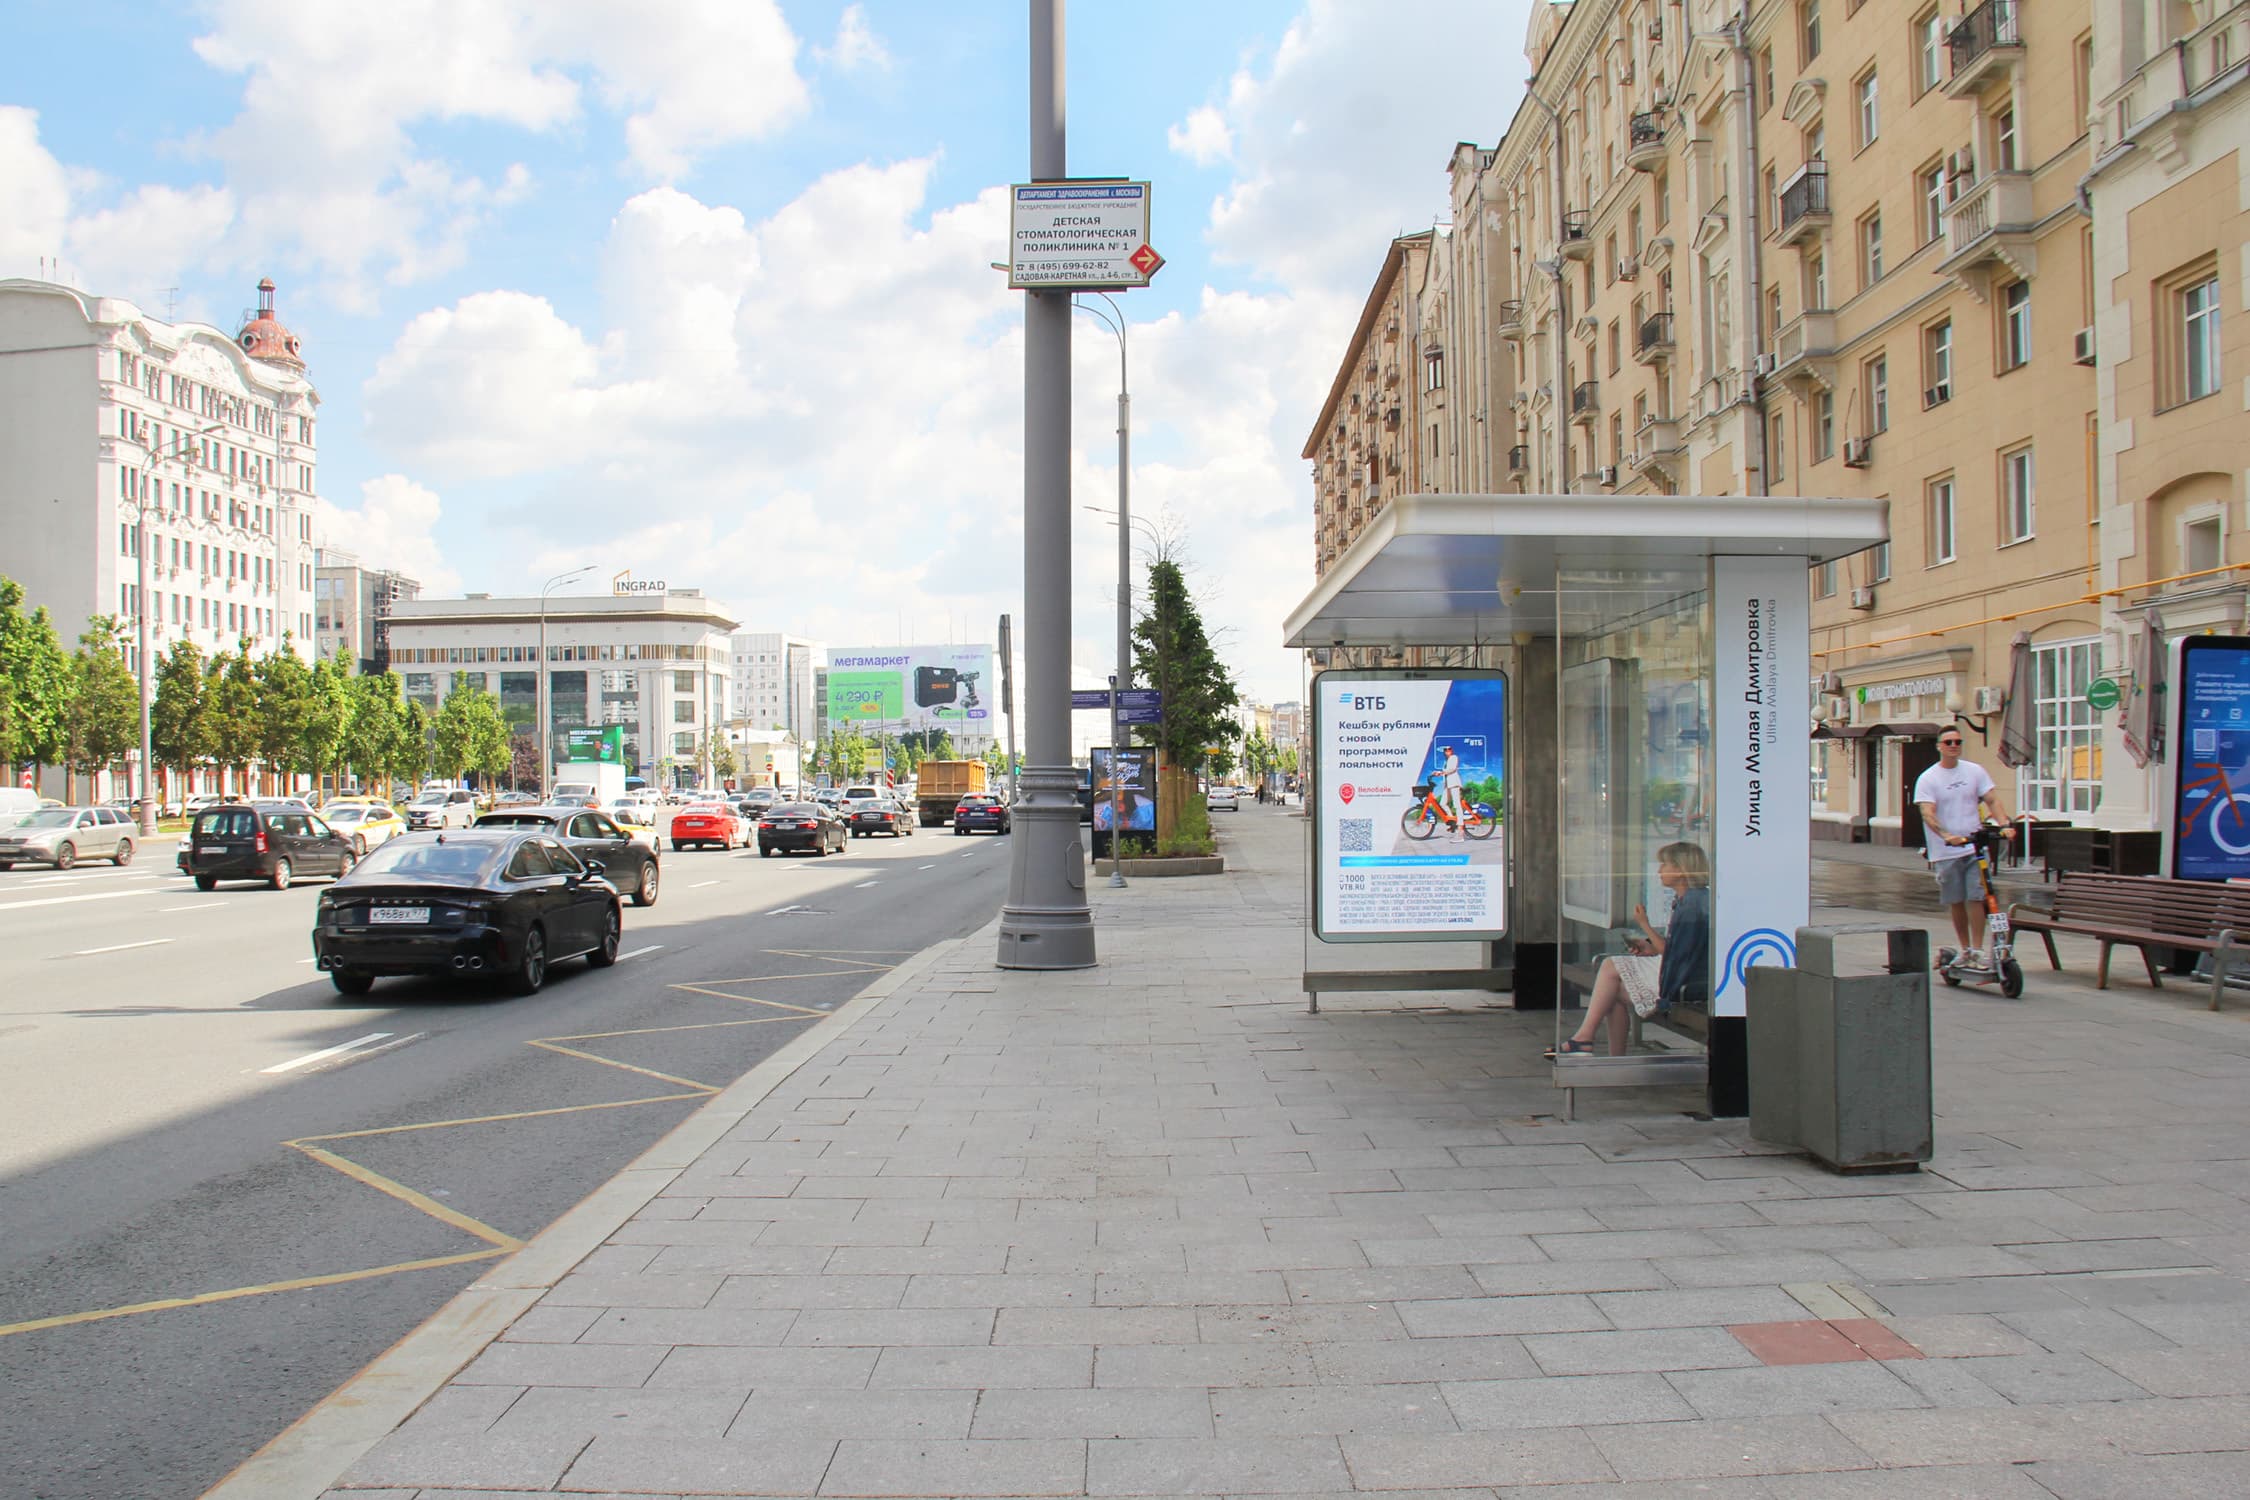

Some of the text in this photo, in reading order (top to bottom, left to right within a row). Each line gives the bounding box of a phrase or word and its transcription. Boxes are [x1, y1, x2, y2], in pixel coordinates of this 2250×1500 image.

[1019, 191, 1057, 199] ДЕПАРТАМЕНТ
[1052, 217, 1100, 226] ДЕТСКАЯ
[1016, 230, 1136, 238] СТОМАТОЛОГИЧЕСКАЯ
[1023, 243, 1105, 252] ПОЛИКЛИНИКА
[1123, 242, 1129, 251] 1
[1036, 262, 1061, 272] (495)
[1062, 262, 1109, 270] 699-62-82
[1016, 272, 1086, 281] САДОВАЯ-КАРЕТНАЯ
[616, 580, 666, 591] INGRAD
[834, 655, 911, 668] мегамаркет
[1766, 598, 1779, 744] Ulitsa Malaya Dmitrovka
[1354, 696, 1386, 710] ВТБ
[1745, 598, 1763, 836] Улица Малая Дмитровка
[1339, 720, 1431, 731] Кешбэк рублями
[1346, 734, 1381, 742] новой
[1339, 746, 1408, 758] программой
